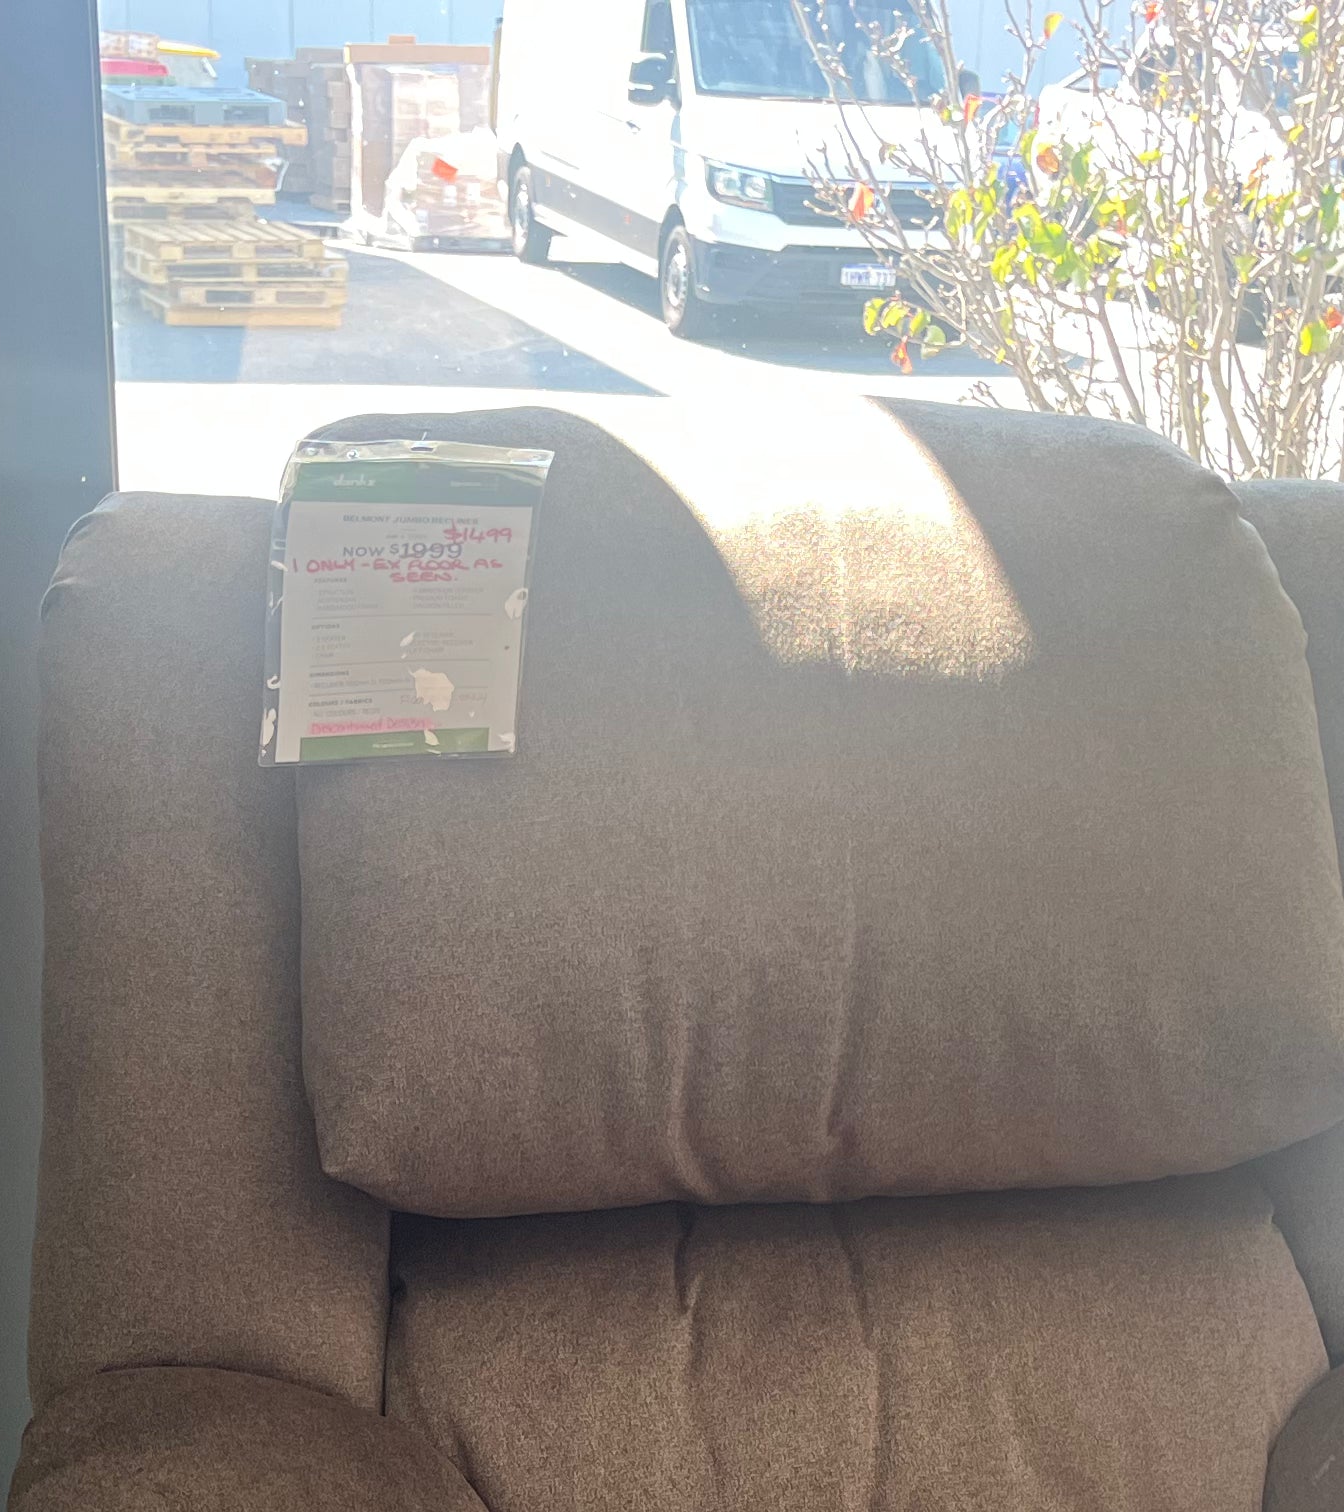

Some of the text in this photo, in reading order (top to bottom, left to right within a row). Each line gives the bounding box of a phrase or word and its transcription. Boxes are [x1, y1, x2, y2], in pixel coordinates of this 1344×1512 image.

[343, 514, 390, 523] BELMONT
[392, 515, 429, 525] JUMBO
[443, 523, 513, 544] $1499
[342, 542, 463, 560] NOW $1999
[306, 559, 356, 573] ONLY
[372, 559, 401, 571] EX
[473, 558, 503, 570] AS
